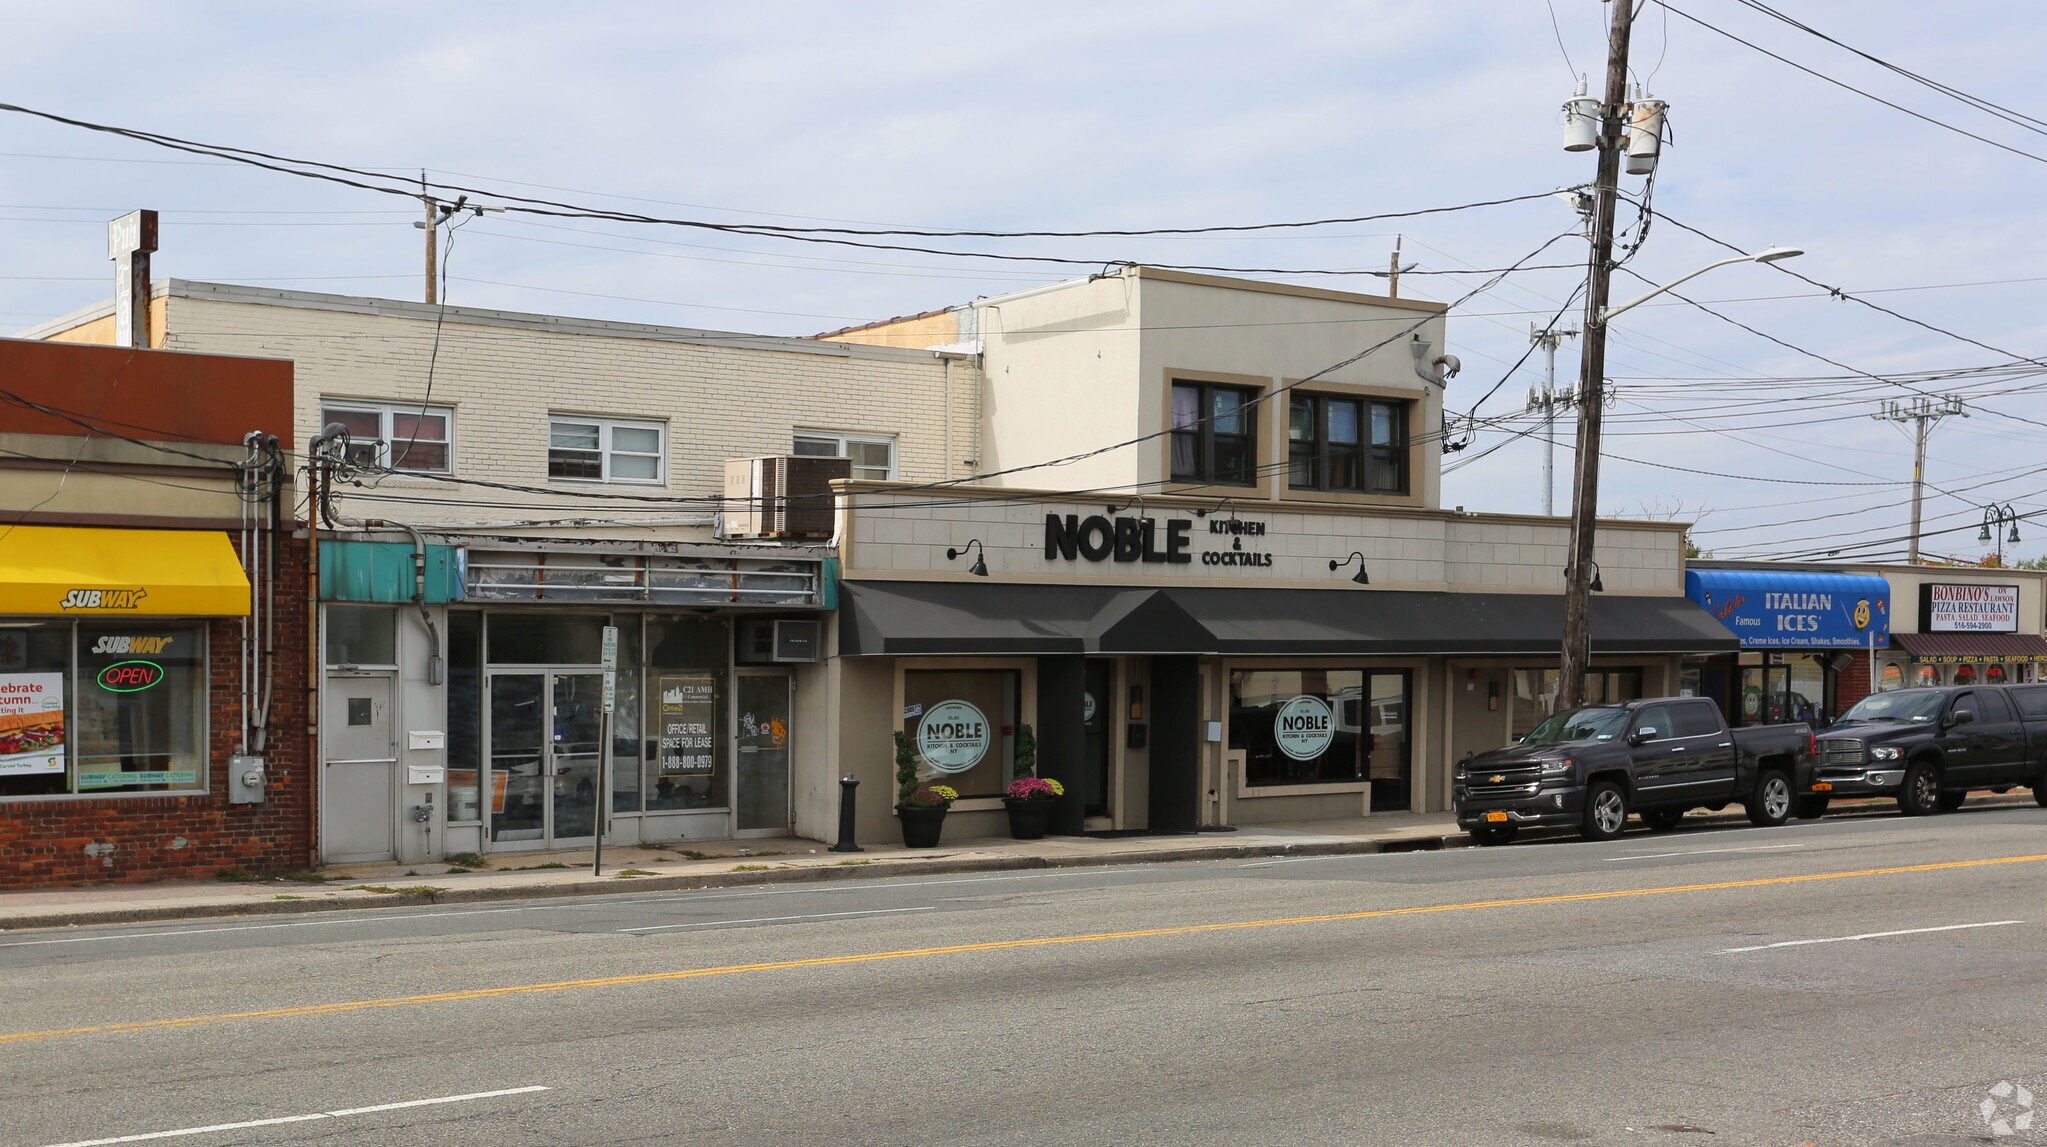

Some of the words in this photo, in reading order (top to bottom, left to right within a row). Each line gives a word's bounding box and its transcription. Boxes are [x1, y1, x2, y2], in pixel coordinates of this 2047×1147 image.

[112, 219, 137, 253] Pub
[1044, 513, 1192, 563] NOBLE
[1232, 537, 1242, 550] &
[1202, 551, 1272, 567] COCKTAILS
[60, 588, 147, 610] SUBWAY
[1933, 586, 1989, 601] BONBINO'S
[1765, 592, 1832, 611] ITALIAN
[1931, 602, 1956, 613] PIZZA
[1958, 602, 2014, 614] RESTAURANT
[1735, 616, 1761, 626] Famous
[1777, 614, 1818, 631] ICES
[1981, 614, 2010, 622] SEAFOOD
[92, 636, 173, 654] SUBWAY
[1748, 637, 1767, 645] Creme
[1768, 637, 1781, 646] Ices,
[1781, 637, 1790, 645] Ice
[1790, 637, 1810, 646] Cream,
[1810, 637, 1831, 646] Shakes,
[106, 667, 154, 684] OPEN
[667, 723, 707, 734] OFFICE/RETAIL
[1283, 716, 1328, 730] NOBLE
[927, 723, 982, 739] NOBLE
[662, 738, 680, 748] SPACE
[681, 738, 693, 748] FOR
[694, 737, 712, 747] LEASE
